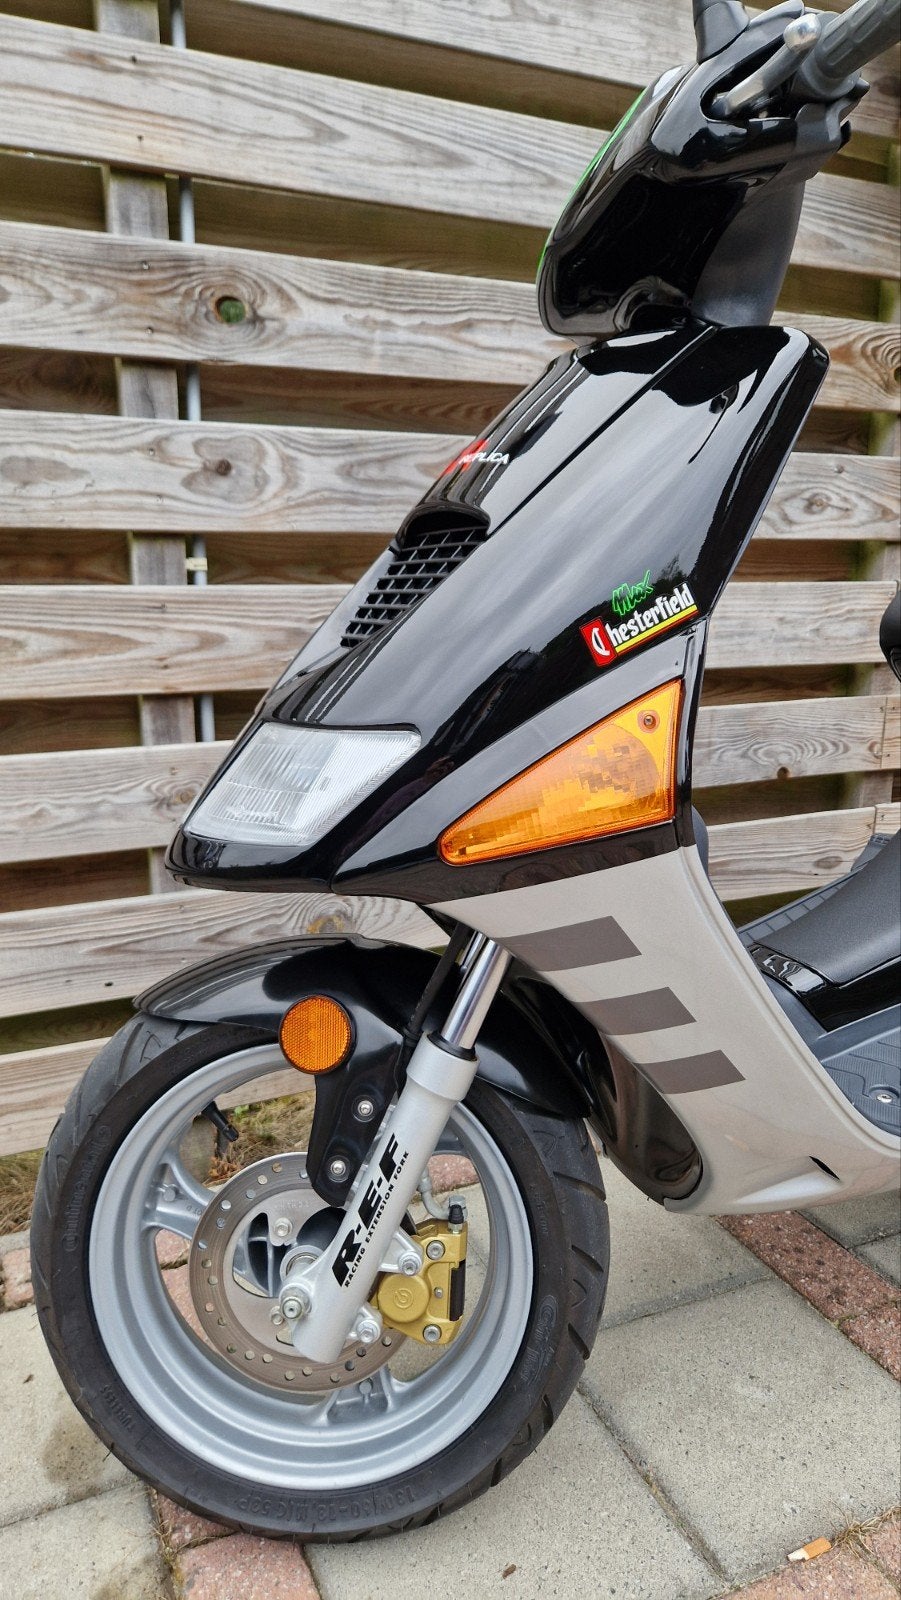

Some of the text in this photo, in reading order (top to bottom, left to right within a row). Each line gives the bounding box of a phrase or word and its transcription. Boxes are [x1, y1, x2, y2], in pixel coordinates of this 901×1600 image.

[591, 582, 695, 656] Chesterfield
[344, 1151, 410, 1288] RACING EXTENSION FORK
